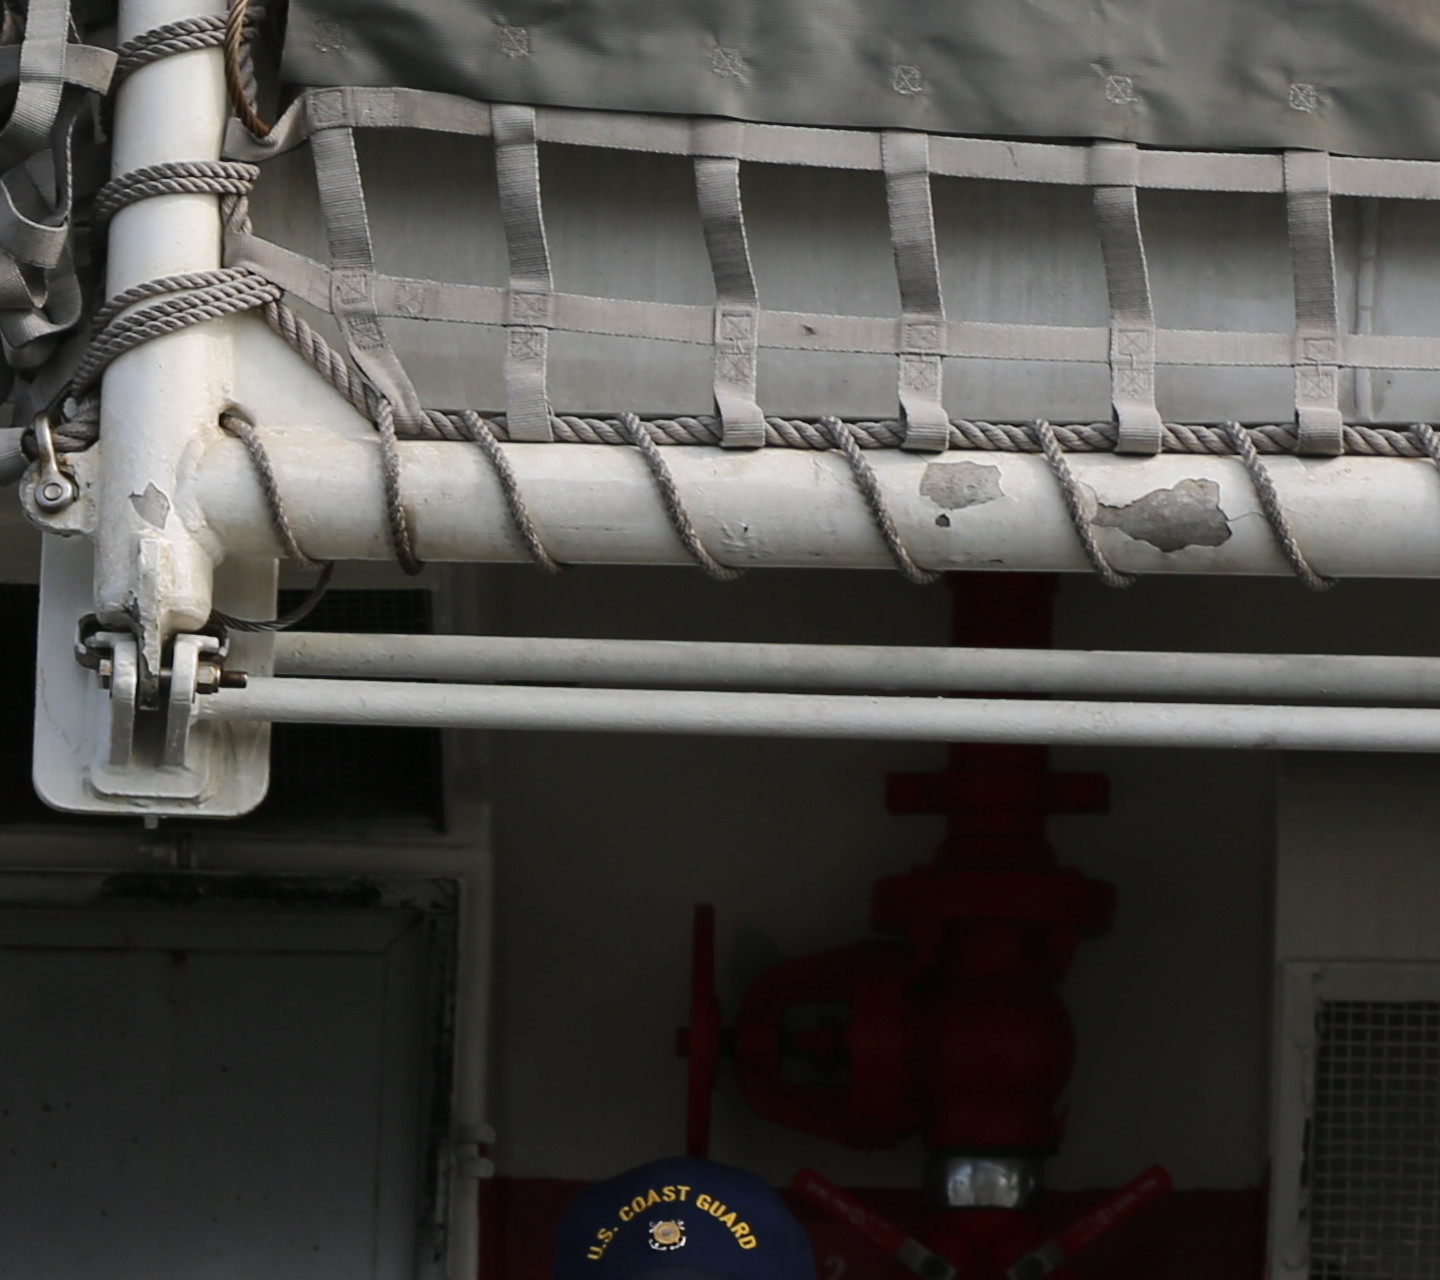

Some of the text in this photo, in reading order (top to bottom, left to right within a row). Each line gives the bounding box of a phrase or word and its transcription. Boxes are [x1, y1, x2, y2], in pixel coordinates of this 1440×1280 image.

[587, 1226, 619, 1261] U.S.
[619, 1184, 691, 1221] COAST
[695, 1194, 758, 1250] GUARD
